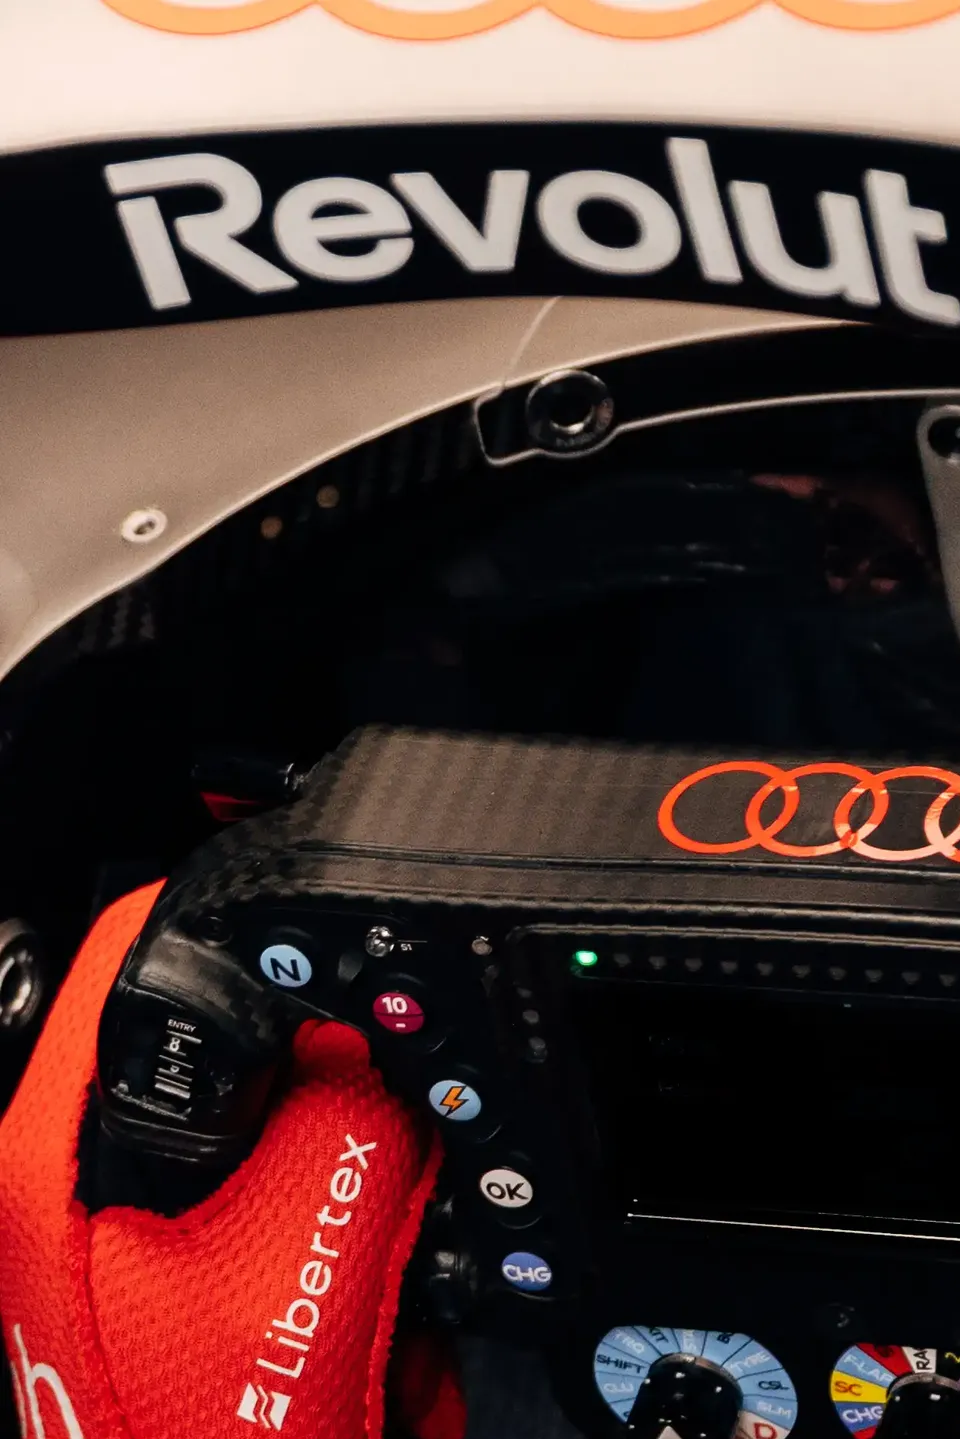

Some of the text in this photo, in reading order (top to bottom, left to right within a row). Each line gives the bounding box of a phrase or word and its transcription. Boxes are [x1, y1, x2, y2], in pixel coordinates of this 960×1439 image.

[400, 943, 412, 951] S1
[270, 958, 301, 981] N
[382, 997, 407, 1014] 10
[167, 1018, 197, 1033] ENTRY
[169, 1037, 181, 1052] 8
[486, 1182, 529, 1200] OK
[256, 1133, 378, 1379] Libertex
[502, 1264, 552, 1282] CHG
[597, 1353, 647, 1375] SHIFT
[914, 1347, 932, 1372] RA
[834, 1380, 863, 1397] SC
[842, 1405, 883, 1424] CHG
